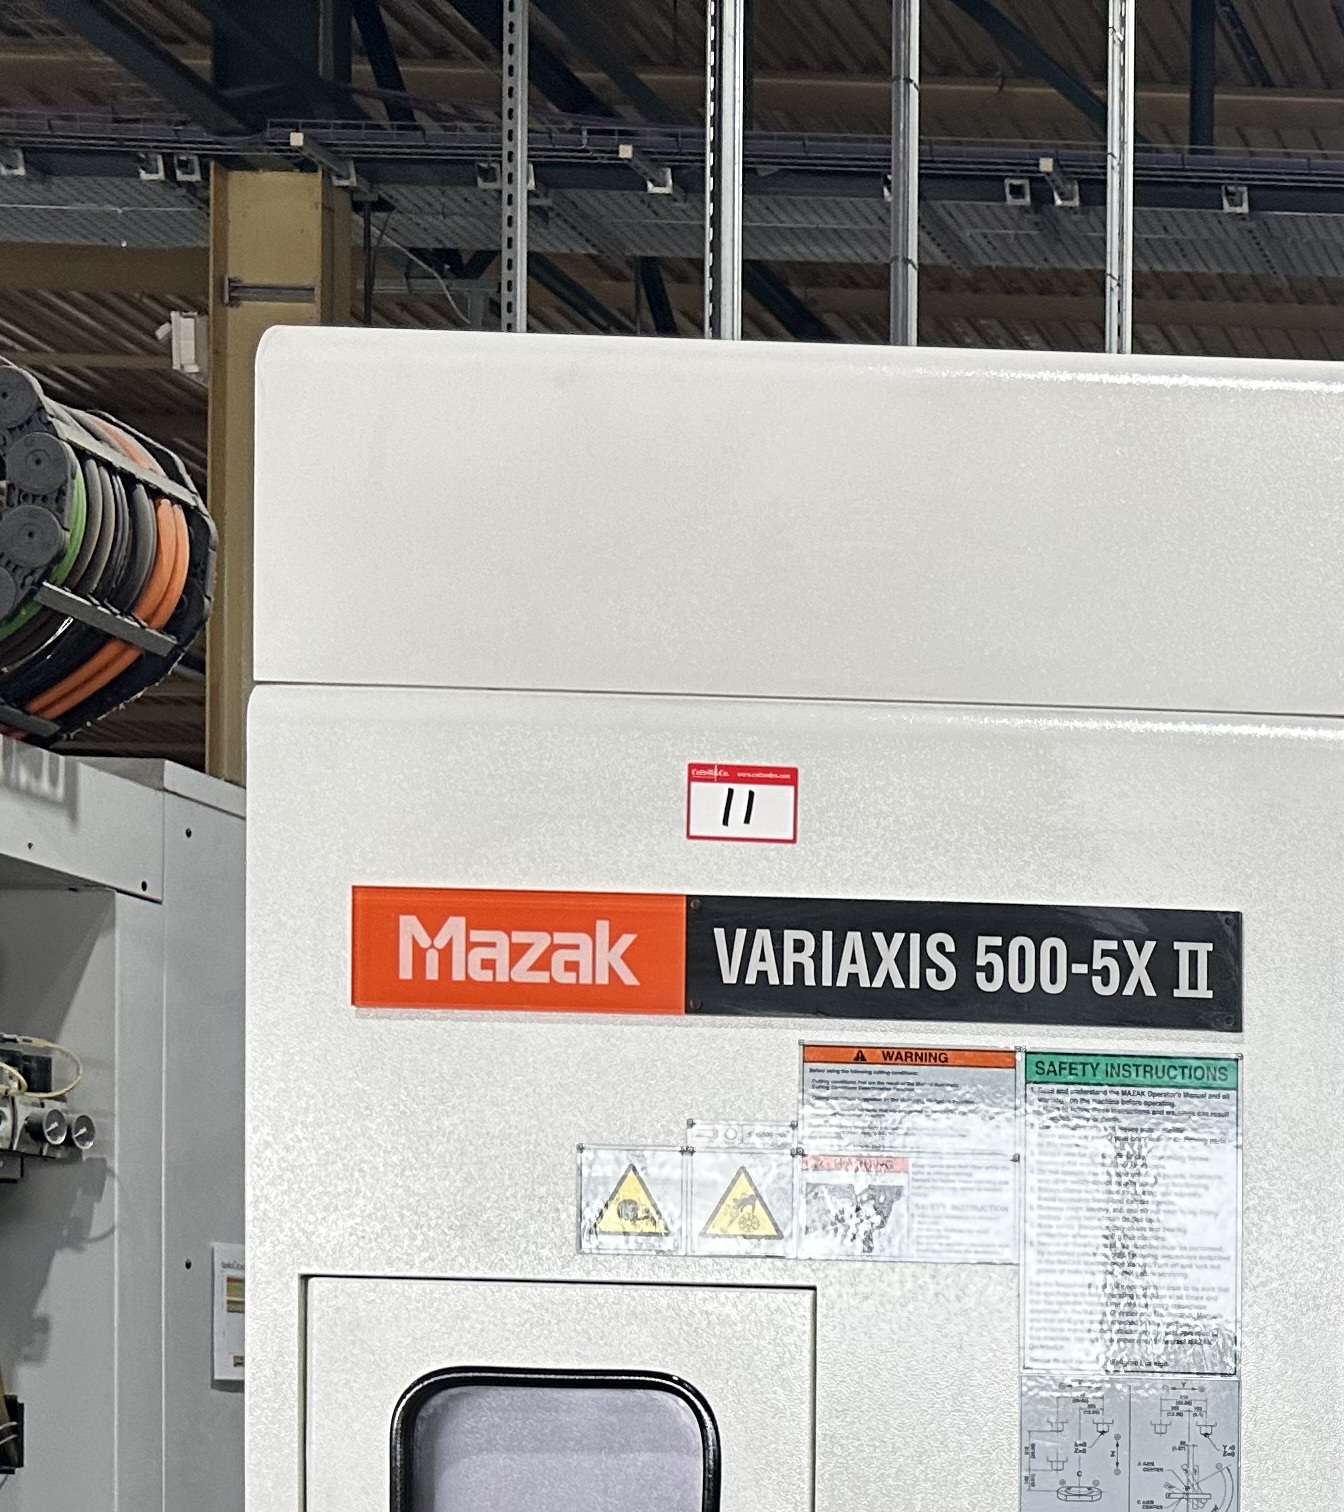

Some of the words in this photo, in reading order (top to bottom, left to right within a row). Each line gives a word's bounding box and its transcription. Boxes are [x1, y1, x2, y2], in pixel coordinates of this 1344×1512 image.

[722, 788, 755, 827] 11
[398, 914, 640, 986] Mazak
[713, 927, 957, 991] VARIAXIS
[975, 936, 1158, 997] 500-5X
[1172, 942, 1214, 998] II
[882, 1050, 949, 1063] WARNING
[1035, 1060, 1100, 1077] SAFETY
[1105, 1063, 1229, 1082] INSTRUCTIONS
